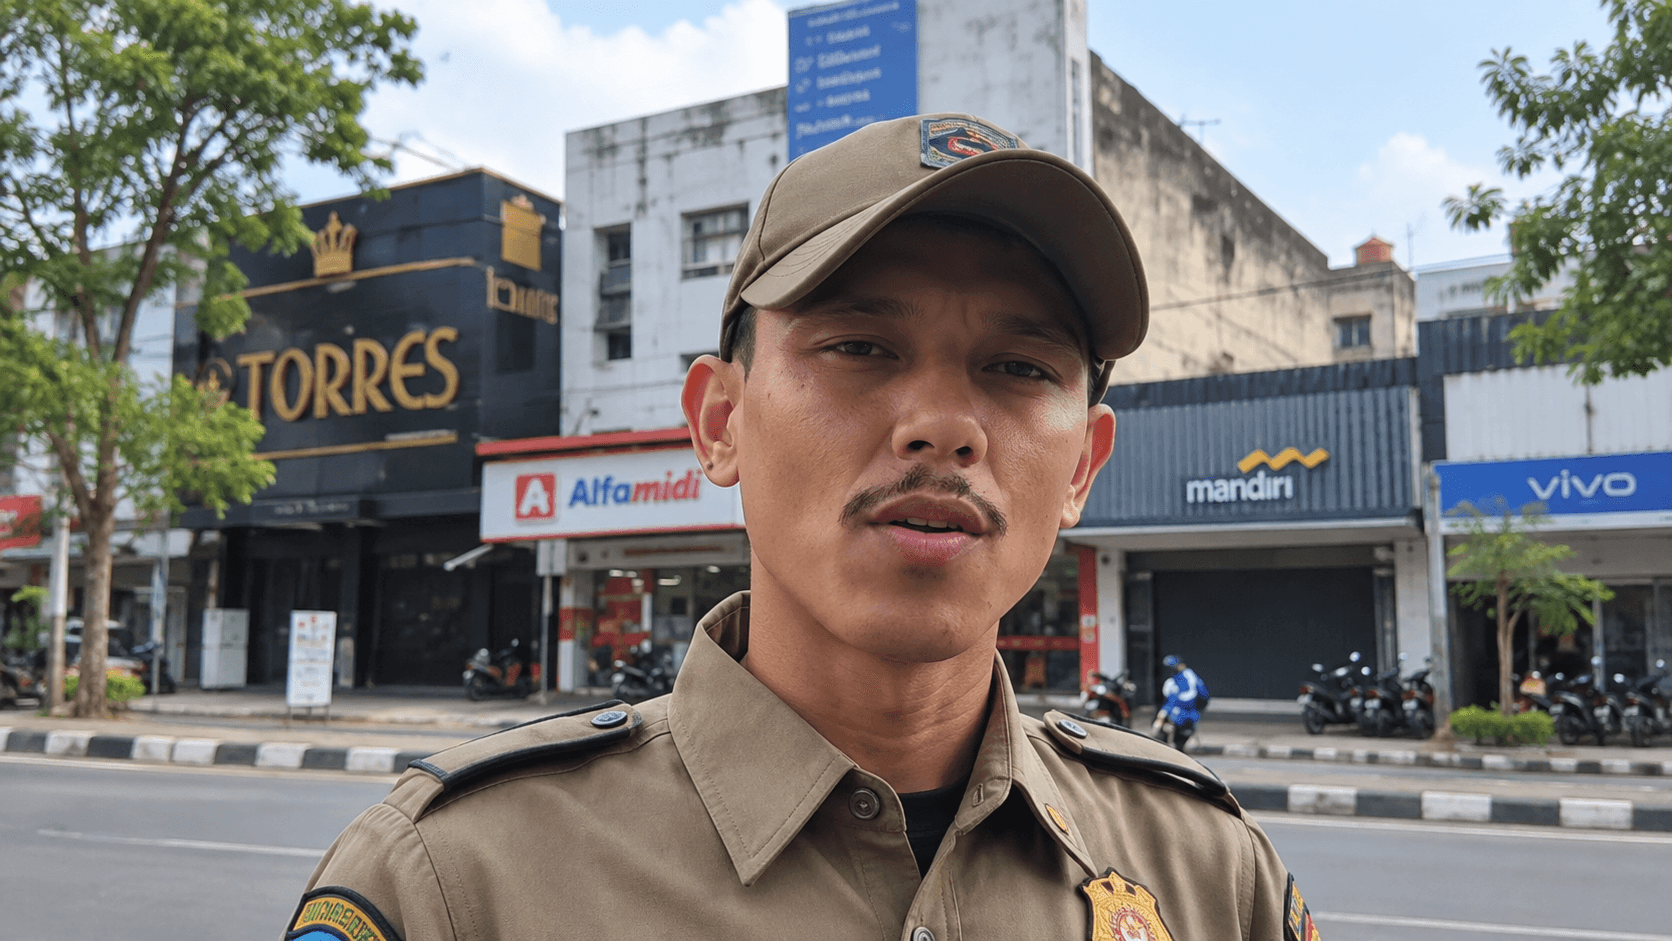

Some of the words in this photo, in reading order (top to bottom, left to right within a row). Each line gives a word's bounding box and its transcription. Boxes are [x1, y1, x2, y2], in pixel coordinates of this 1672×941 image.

[236, 326, 460, 422] TORRES
[518, 477, 550, 516] A
[568, 468, 703, 509] Alfamidi
[1186, 470, 1294, 504] mandiri
[1526, 468, 1637, 500] vivo
